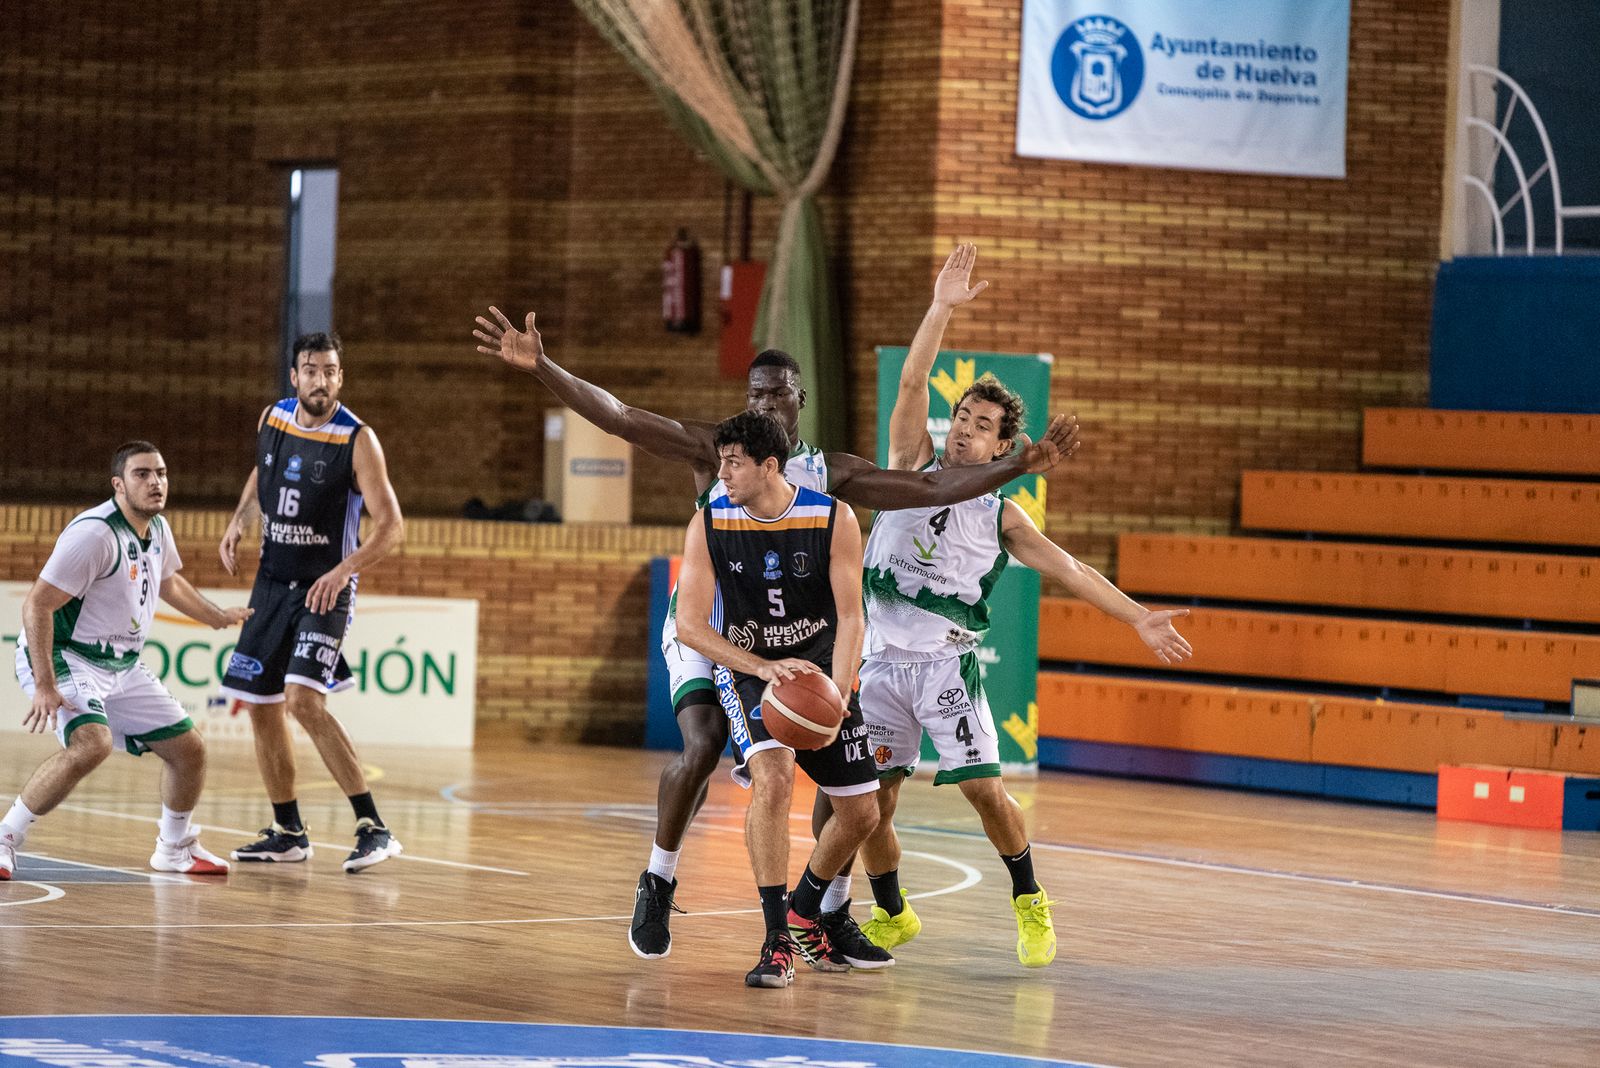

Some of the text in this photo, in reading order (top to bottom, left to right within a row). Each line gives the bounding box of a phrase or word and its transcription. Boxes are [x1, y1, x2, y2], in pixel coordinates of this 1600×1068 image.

[1151, 31, 1317, 63] Ayuntamiento
[1196, 61, 1317, 87] de Huelva
[277, 486, 301, 518] 16
[270, 521, 314, 536] HUELVA
[929, 507, 951, 537] 4
[271, 531, 330, 546] TE SALUDA
[888, 553, 948, 586] Extremadura
[139, 578, 148, 607] 9
[767, 588, 786, 618] 5
[763, 617, 812, 637] HUELVA
[764, 618, 829, 648] TE SALUDA
[938, 701, 970, 716] TOYOTA
[841, 729, 852, 741] EL
[956, 715, 974, 747] 4
[965, 757, 982, 765] errea
